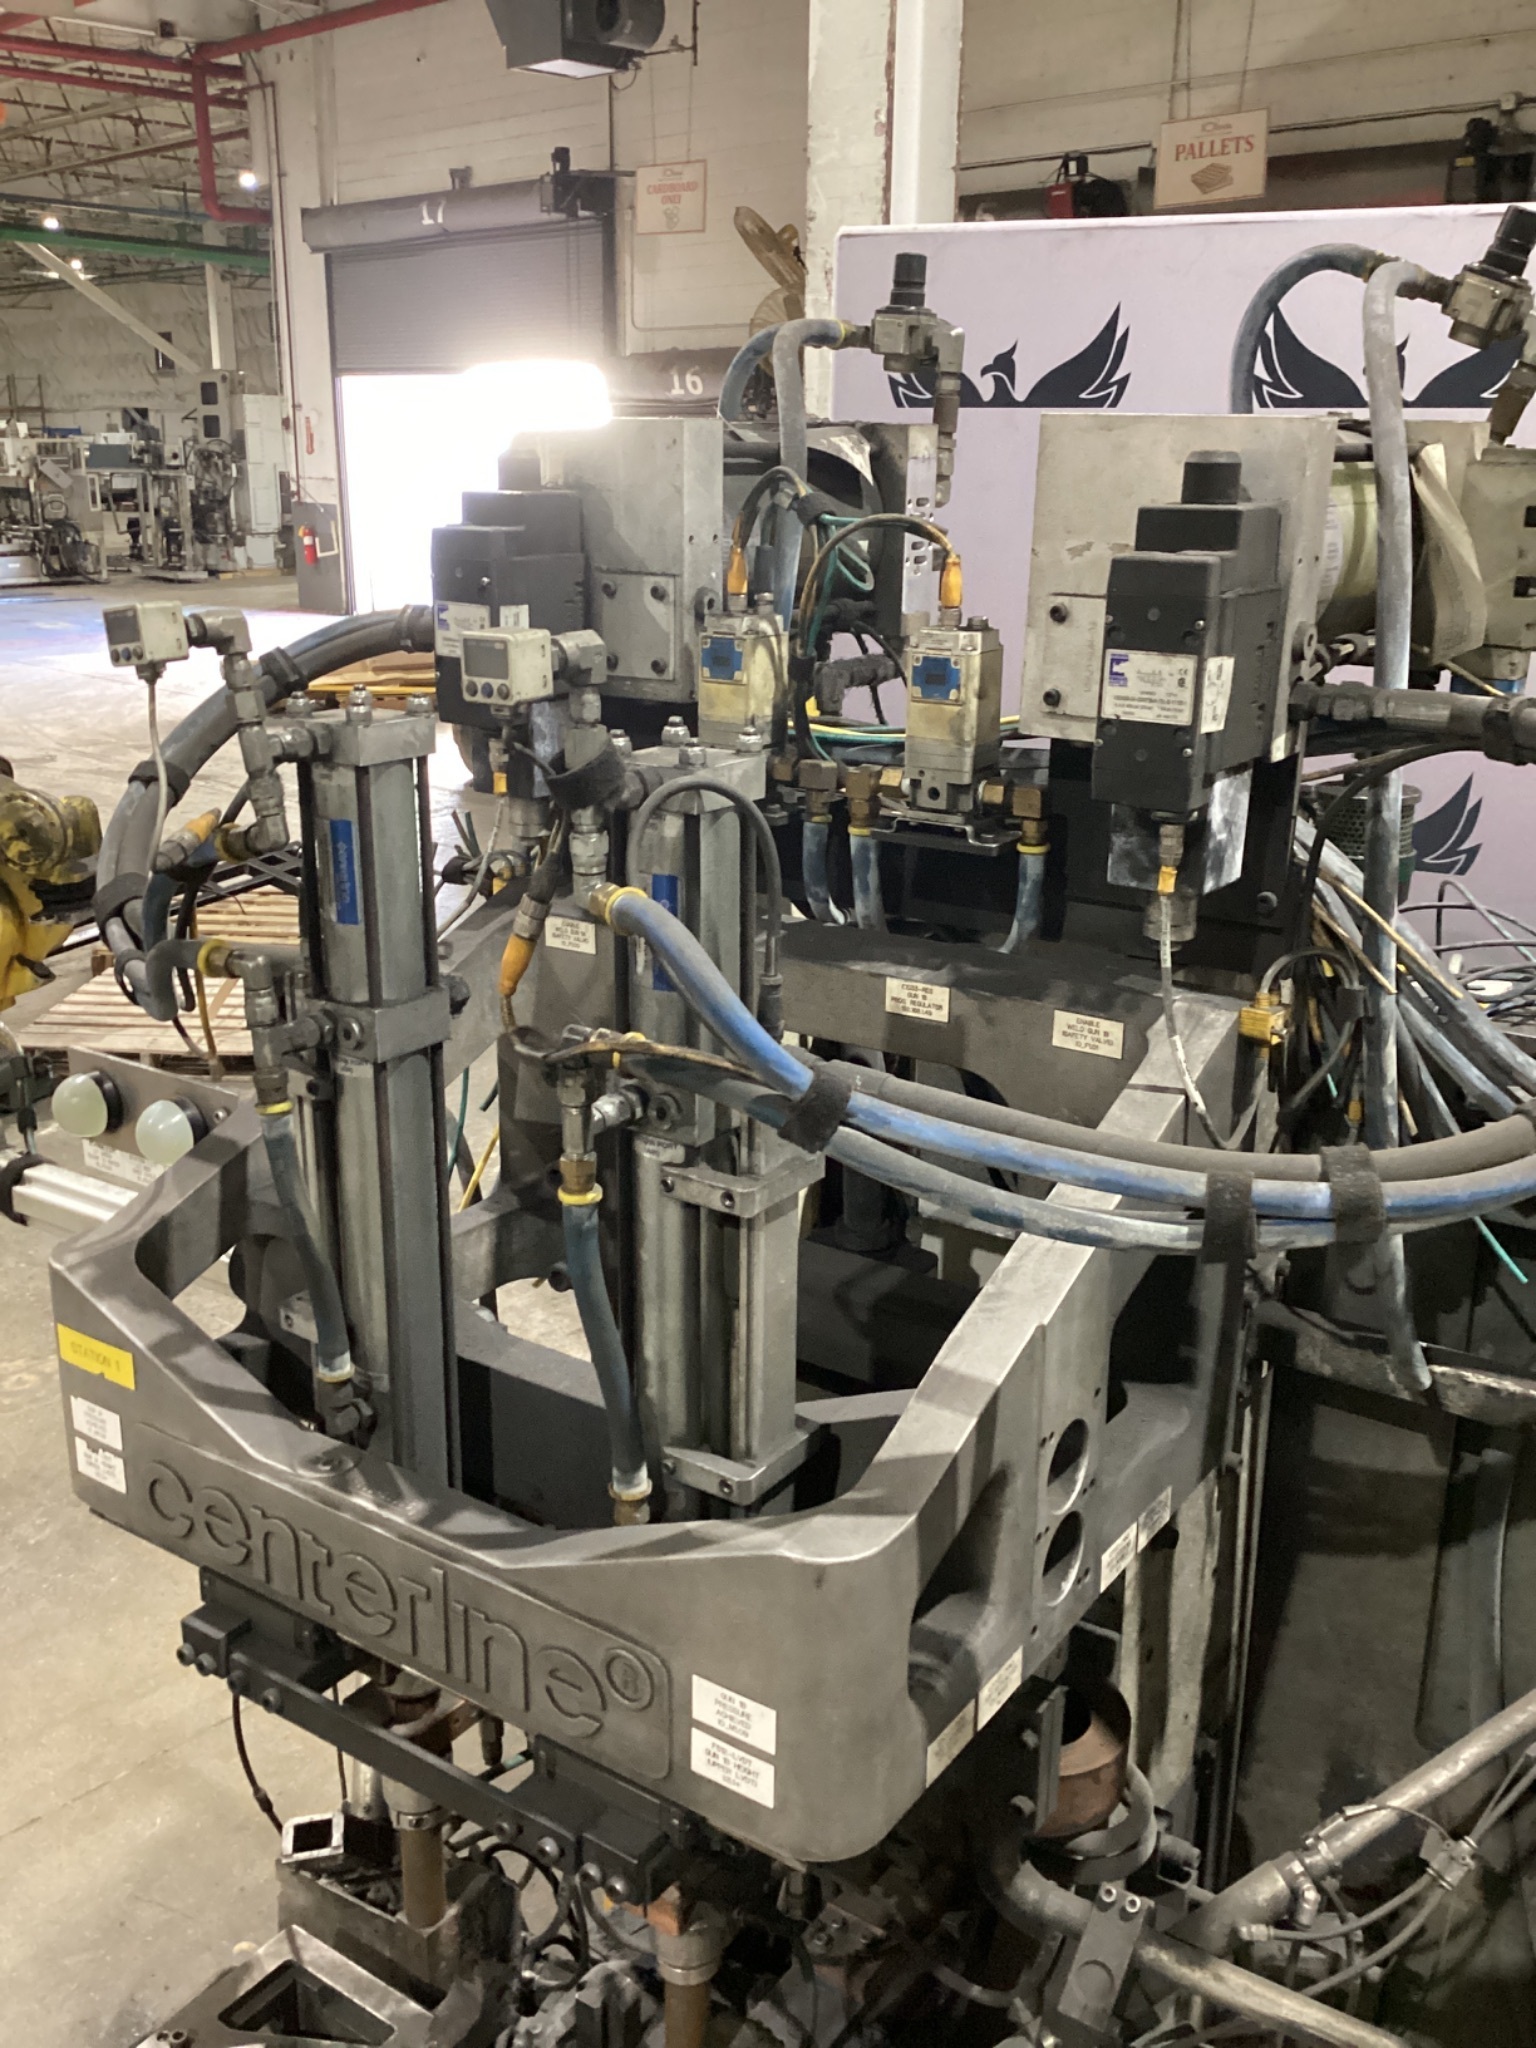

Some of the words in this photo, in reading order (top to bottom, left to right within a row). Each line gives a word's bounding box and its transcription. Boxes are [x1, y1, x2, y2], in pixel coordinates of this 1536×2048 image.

[1175, 134, 1254, 161] PALLETS
[669, 365, 703, 395] 16
[1067, 1023, 1083, 1032] WELD
[1087, 1027, 1099, 1035] GUN
[714, 1699, 751, 1722] PRESSURE
[720, 1693, 734, 1705] GUN
[705, 1749, 719, 1761] GUN
[733, 1763, 758, 1780] HEIGHT
